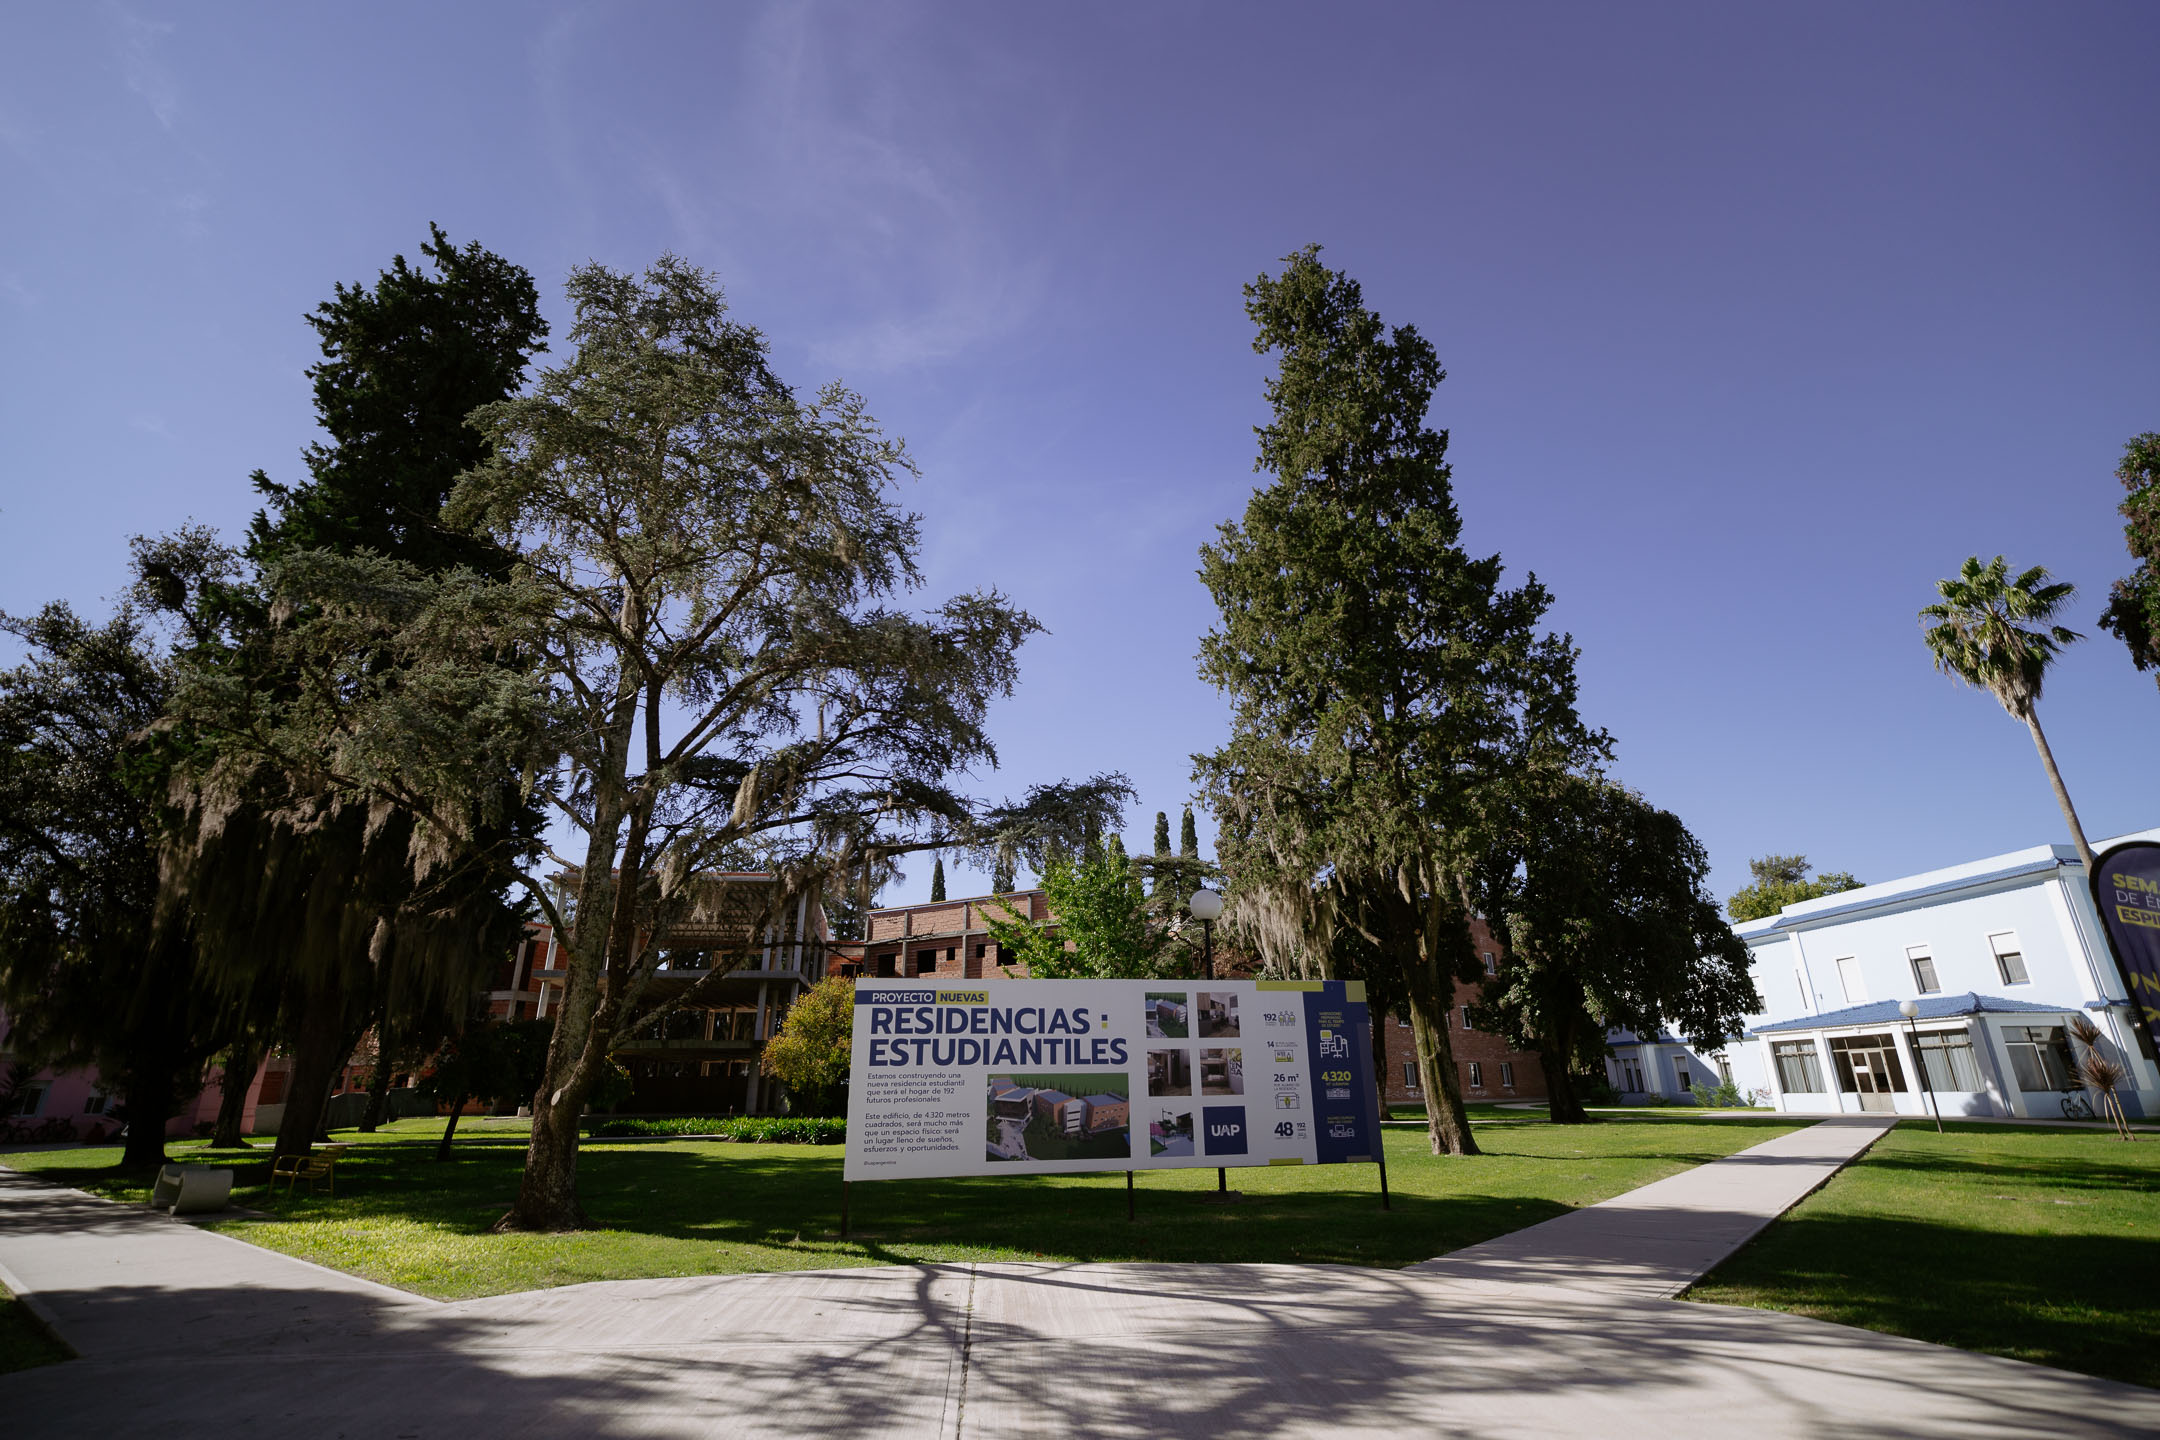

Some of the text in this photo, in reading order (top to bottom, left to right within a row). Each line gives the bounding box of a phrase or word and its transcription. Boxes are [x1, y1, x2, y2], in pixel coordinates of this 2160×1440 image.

[2112, 873, 2160, 895] SEM
[2116, 889, 2139, 905] DE
[872, 992, 985, 1003] PROYECTO NUEVAS
[870, 1007, 1091, 1035] RESIDENCIAS
[1263, 1013, 1277, 1021] 192
[868, 1038, 1129, 1067] ESTUDIANTILES
[898, 1072, 946, 1080] construyendo
[1274, 1073, 1285, 1082] 26
[909, 1088, 929, 1096] hogar
[883, 1112, 911, 1120] edificio,
[1211, 1124, 1240, 1137] UAP
[1274, 1121, 1294, 1136] 48
[875, 1137, 894, 1145] lugar
